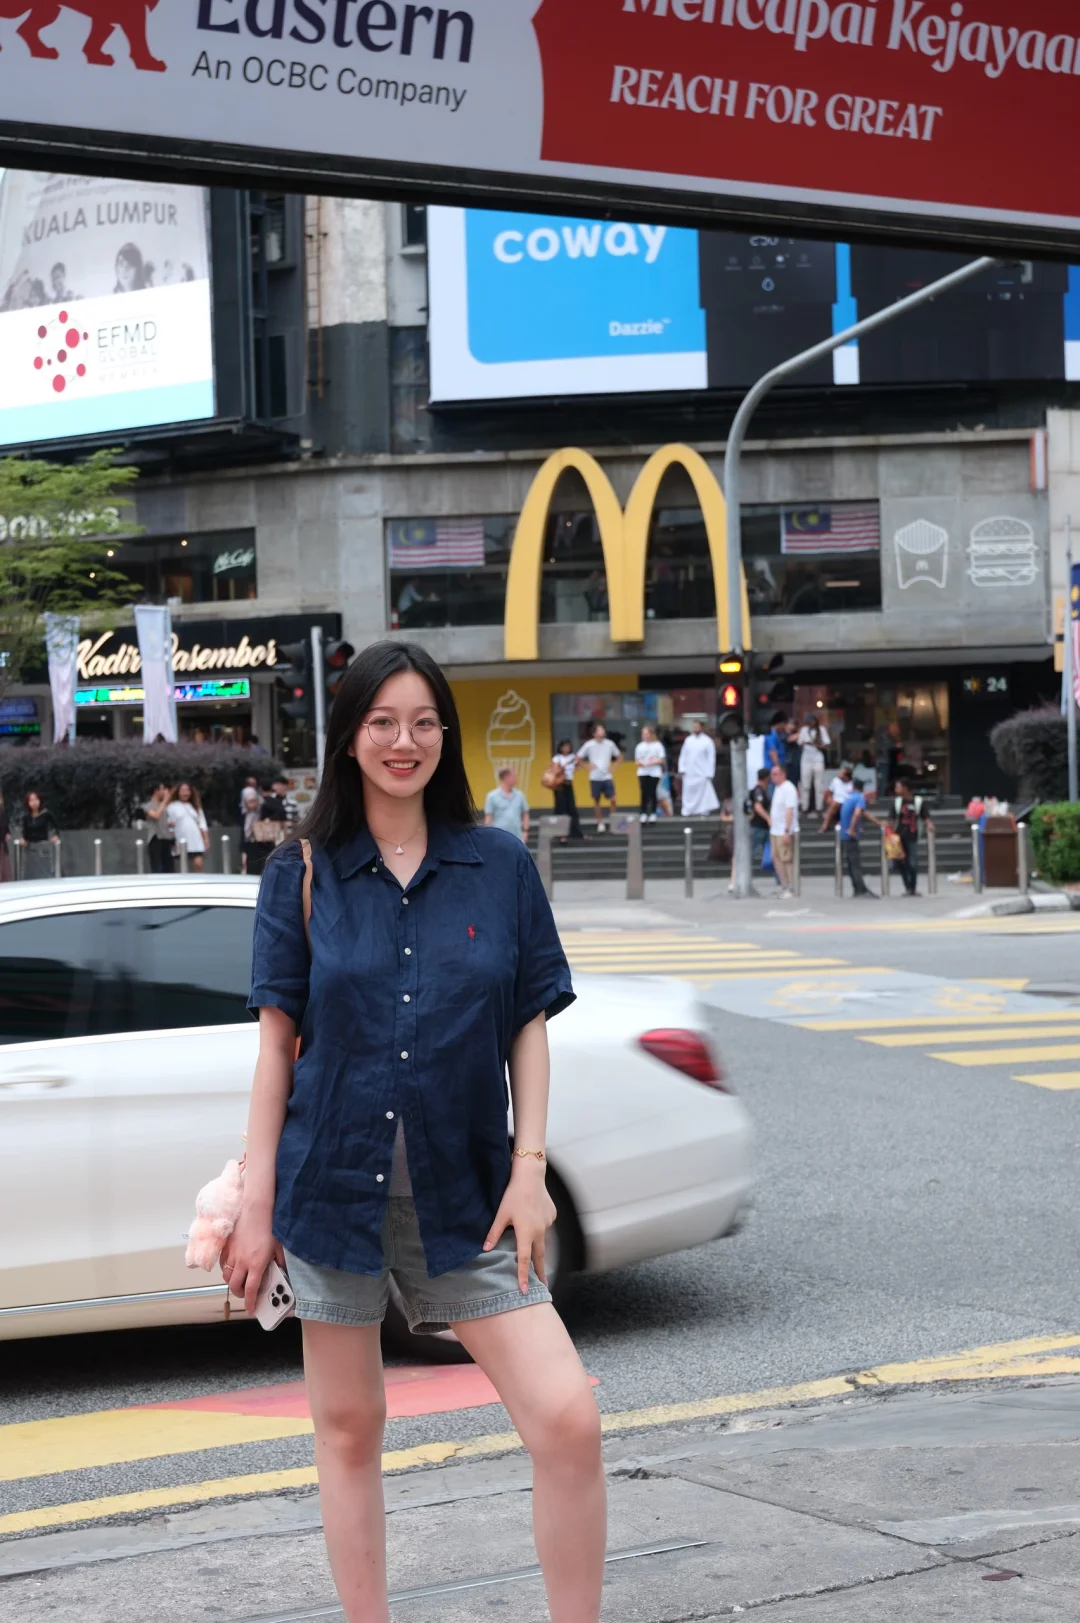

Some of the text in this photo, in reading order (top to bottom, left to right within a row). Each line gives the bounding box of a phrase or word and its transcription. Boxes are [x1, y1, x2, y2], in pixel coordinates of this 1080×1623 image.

[621, 0, 1080, 79] encapai Kejayaa
[191, 50, 467, 112] An OCBC Company
[609, 64, 944, 141] REACH FOR GREAT
[23, 201, 178, 245] KUALA LUMPUR
[493, 222, 667, 263] coway
[97, 320, 157, 348] EFMD
[76, 631, 142, 679] Kadir
[987, 676, 1007, 692] 24
